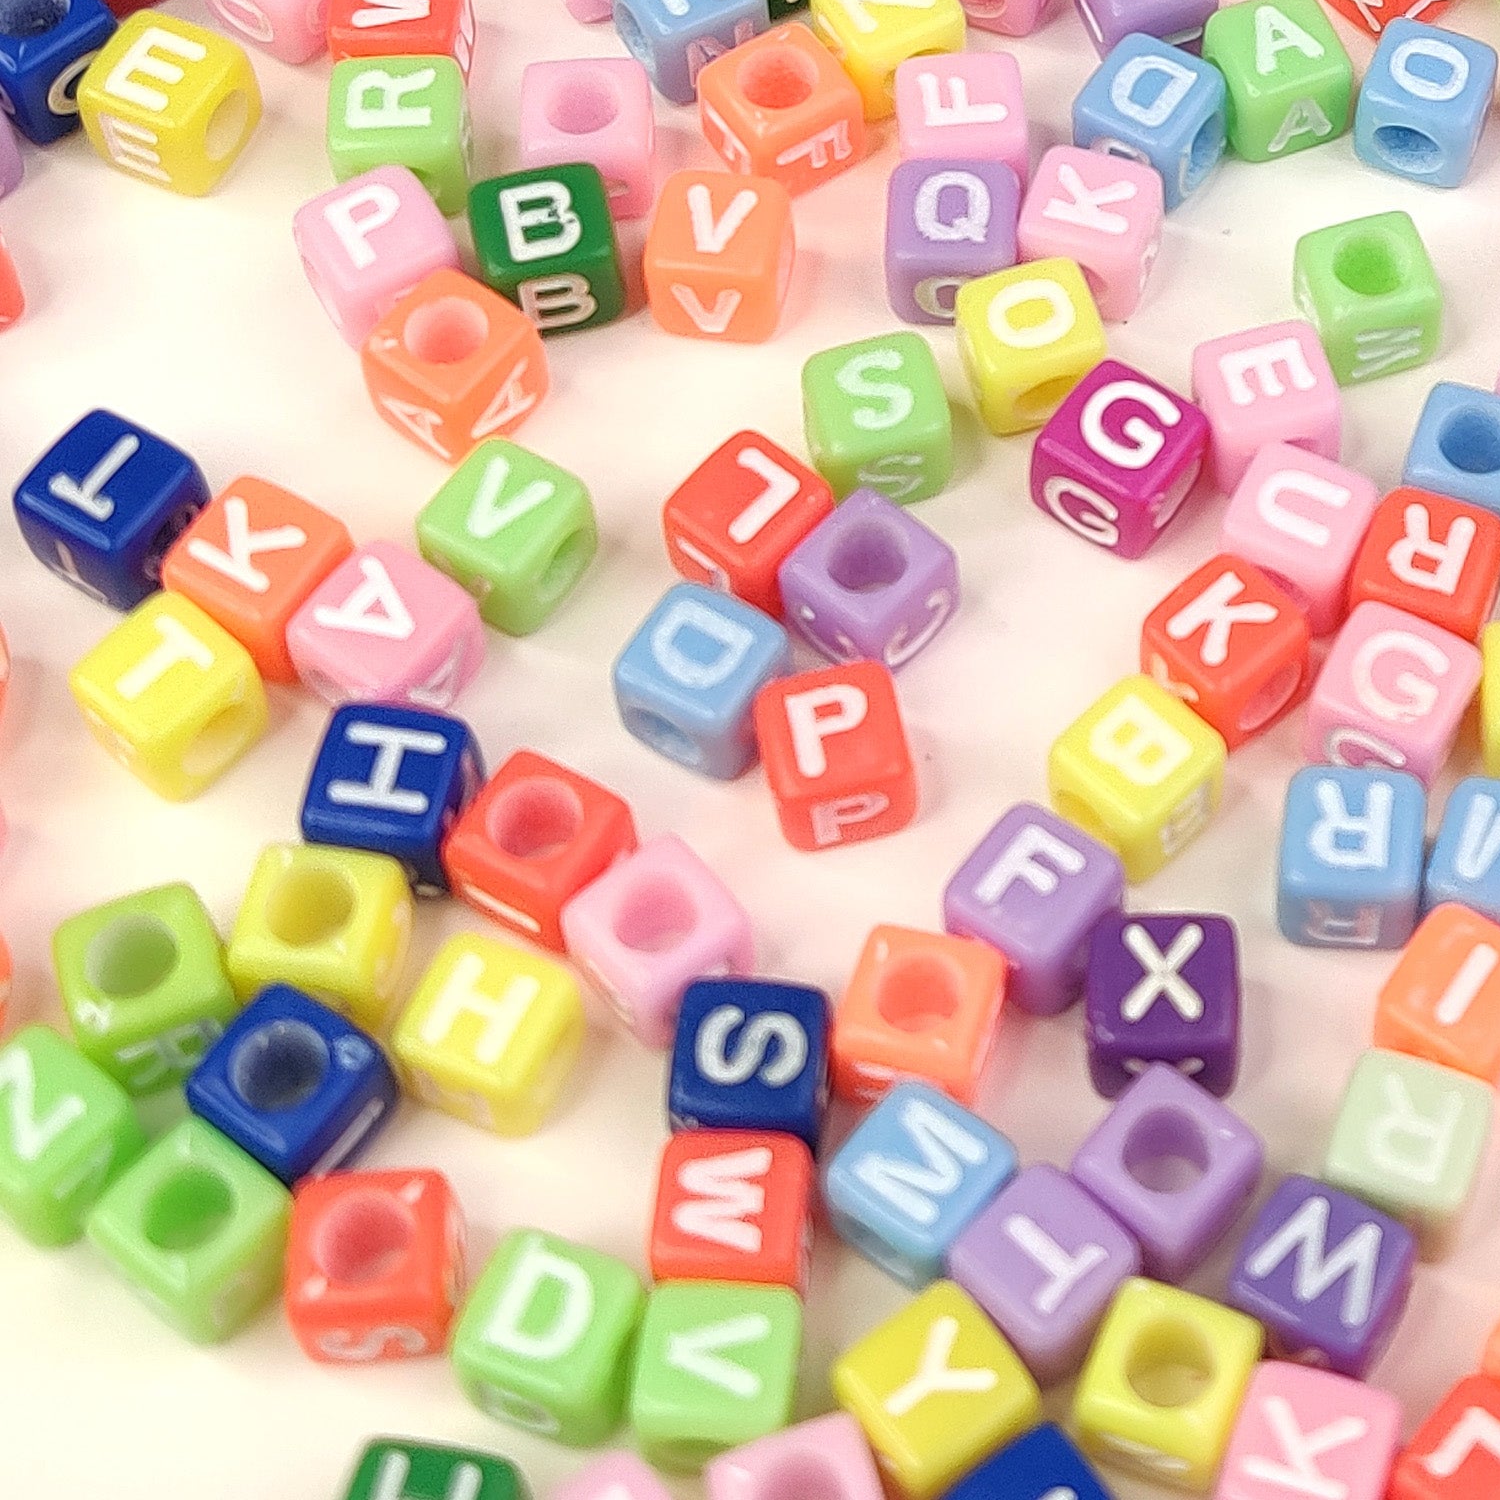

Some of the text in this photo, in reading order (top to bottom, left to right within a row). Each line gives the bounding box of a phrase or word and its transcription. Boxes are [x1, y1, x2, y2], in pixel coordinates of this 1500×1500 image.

[1254, 4, 1325, 76] A
[1390, 37, 1469, 100] O
[344, 66, 436, 128] R
[324, 184, 401, 269] P
[499, 180, 582, 262] B
[687, 184, 759, 253] V
[914, 171, 991, 243] Q
[517, 274, 598, 330] B
[987, 279, 1075, 347] O
[837, 349, 915, 429] S
[1079, 379, 1182, 470] G
[49, 434, 140, 520] T
[466, 456, 555, 538] V
[728, 447, 799, 544] L
[1042, 475, 1119, 546] G
[188, 496, 306, 592] K
[1389, 503, 1477, 594] R
[114, 615, 214, 700] T
[650, 599, 754, 687] D
[1166, 571, 1278, 665] K
[1351, 630, 1451, 721] G
[328, 722, 446, 815] H
[784, 683, 868, 778] P
[1090, 694, 1193, 786] B
[976, 824, 1085, 902] F
[1310, 781, 1394, 870] R
[421, 954, 538, 1063] H
[1121, 922, 1204, 1020] X
[693, 1005, 809, 1088] S
[485, 1252, 592, 1358] D
[665, 1313, 770, 1396] V
[885, 1316, 998, 1415] Y
